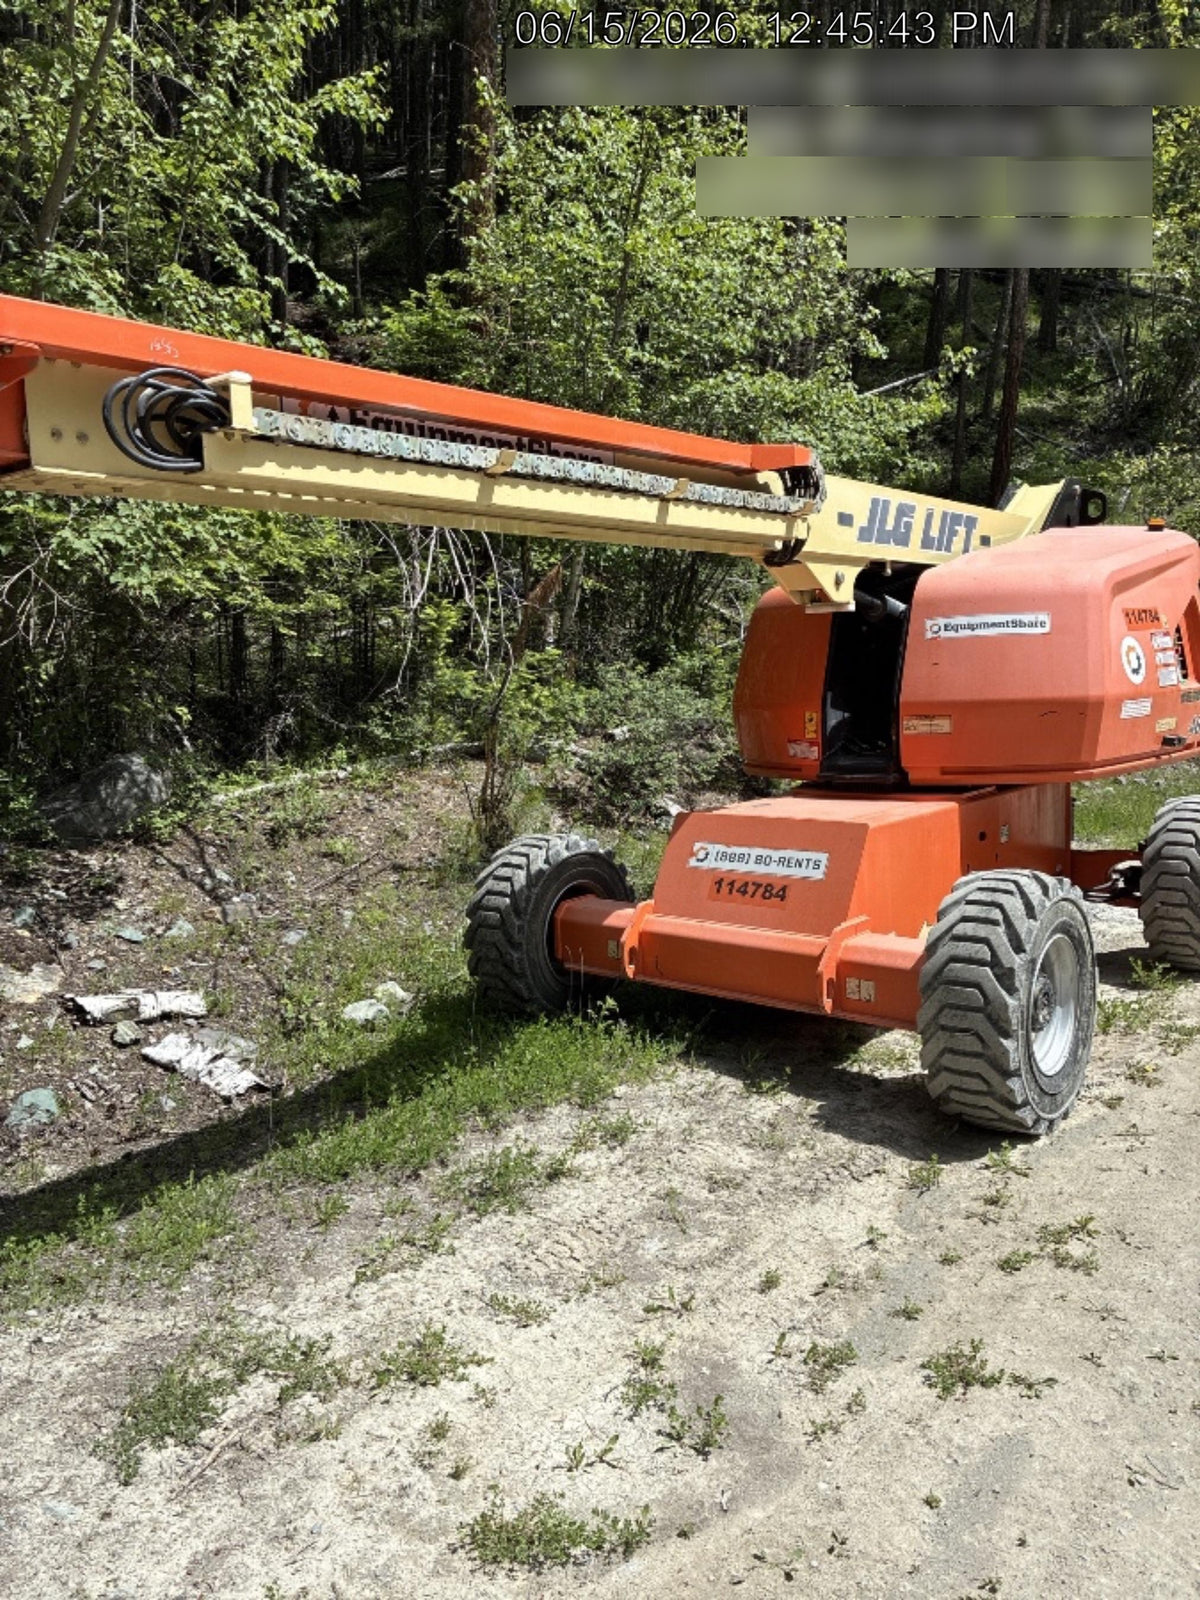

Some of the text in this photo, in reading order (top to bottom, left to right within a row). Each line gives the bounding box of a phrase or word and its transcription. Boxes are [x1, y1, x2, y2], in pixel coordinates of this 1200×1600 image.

[857, 497, 979, 554] JLG LIFT
[1125, 608, 1160, 625] 114784
[754, 854, 822, 870] 80-RENTS
[714, 878, 788, 901] 114784
